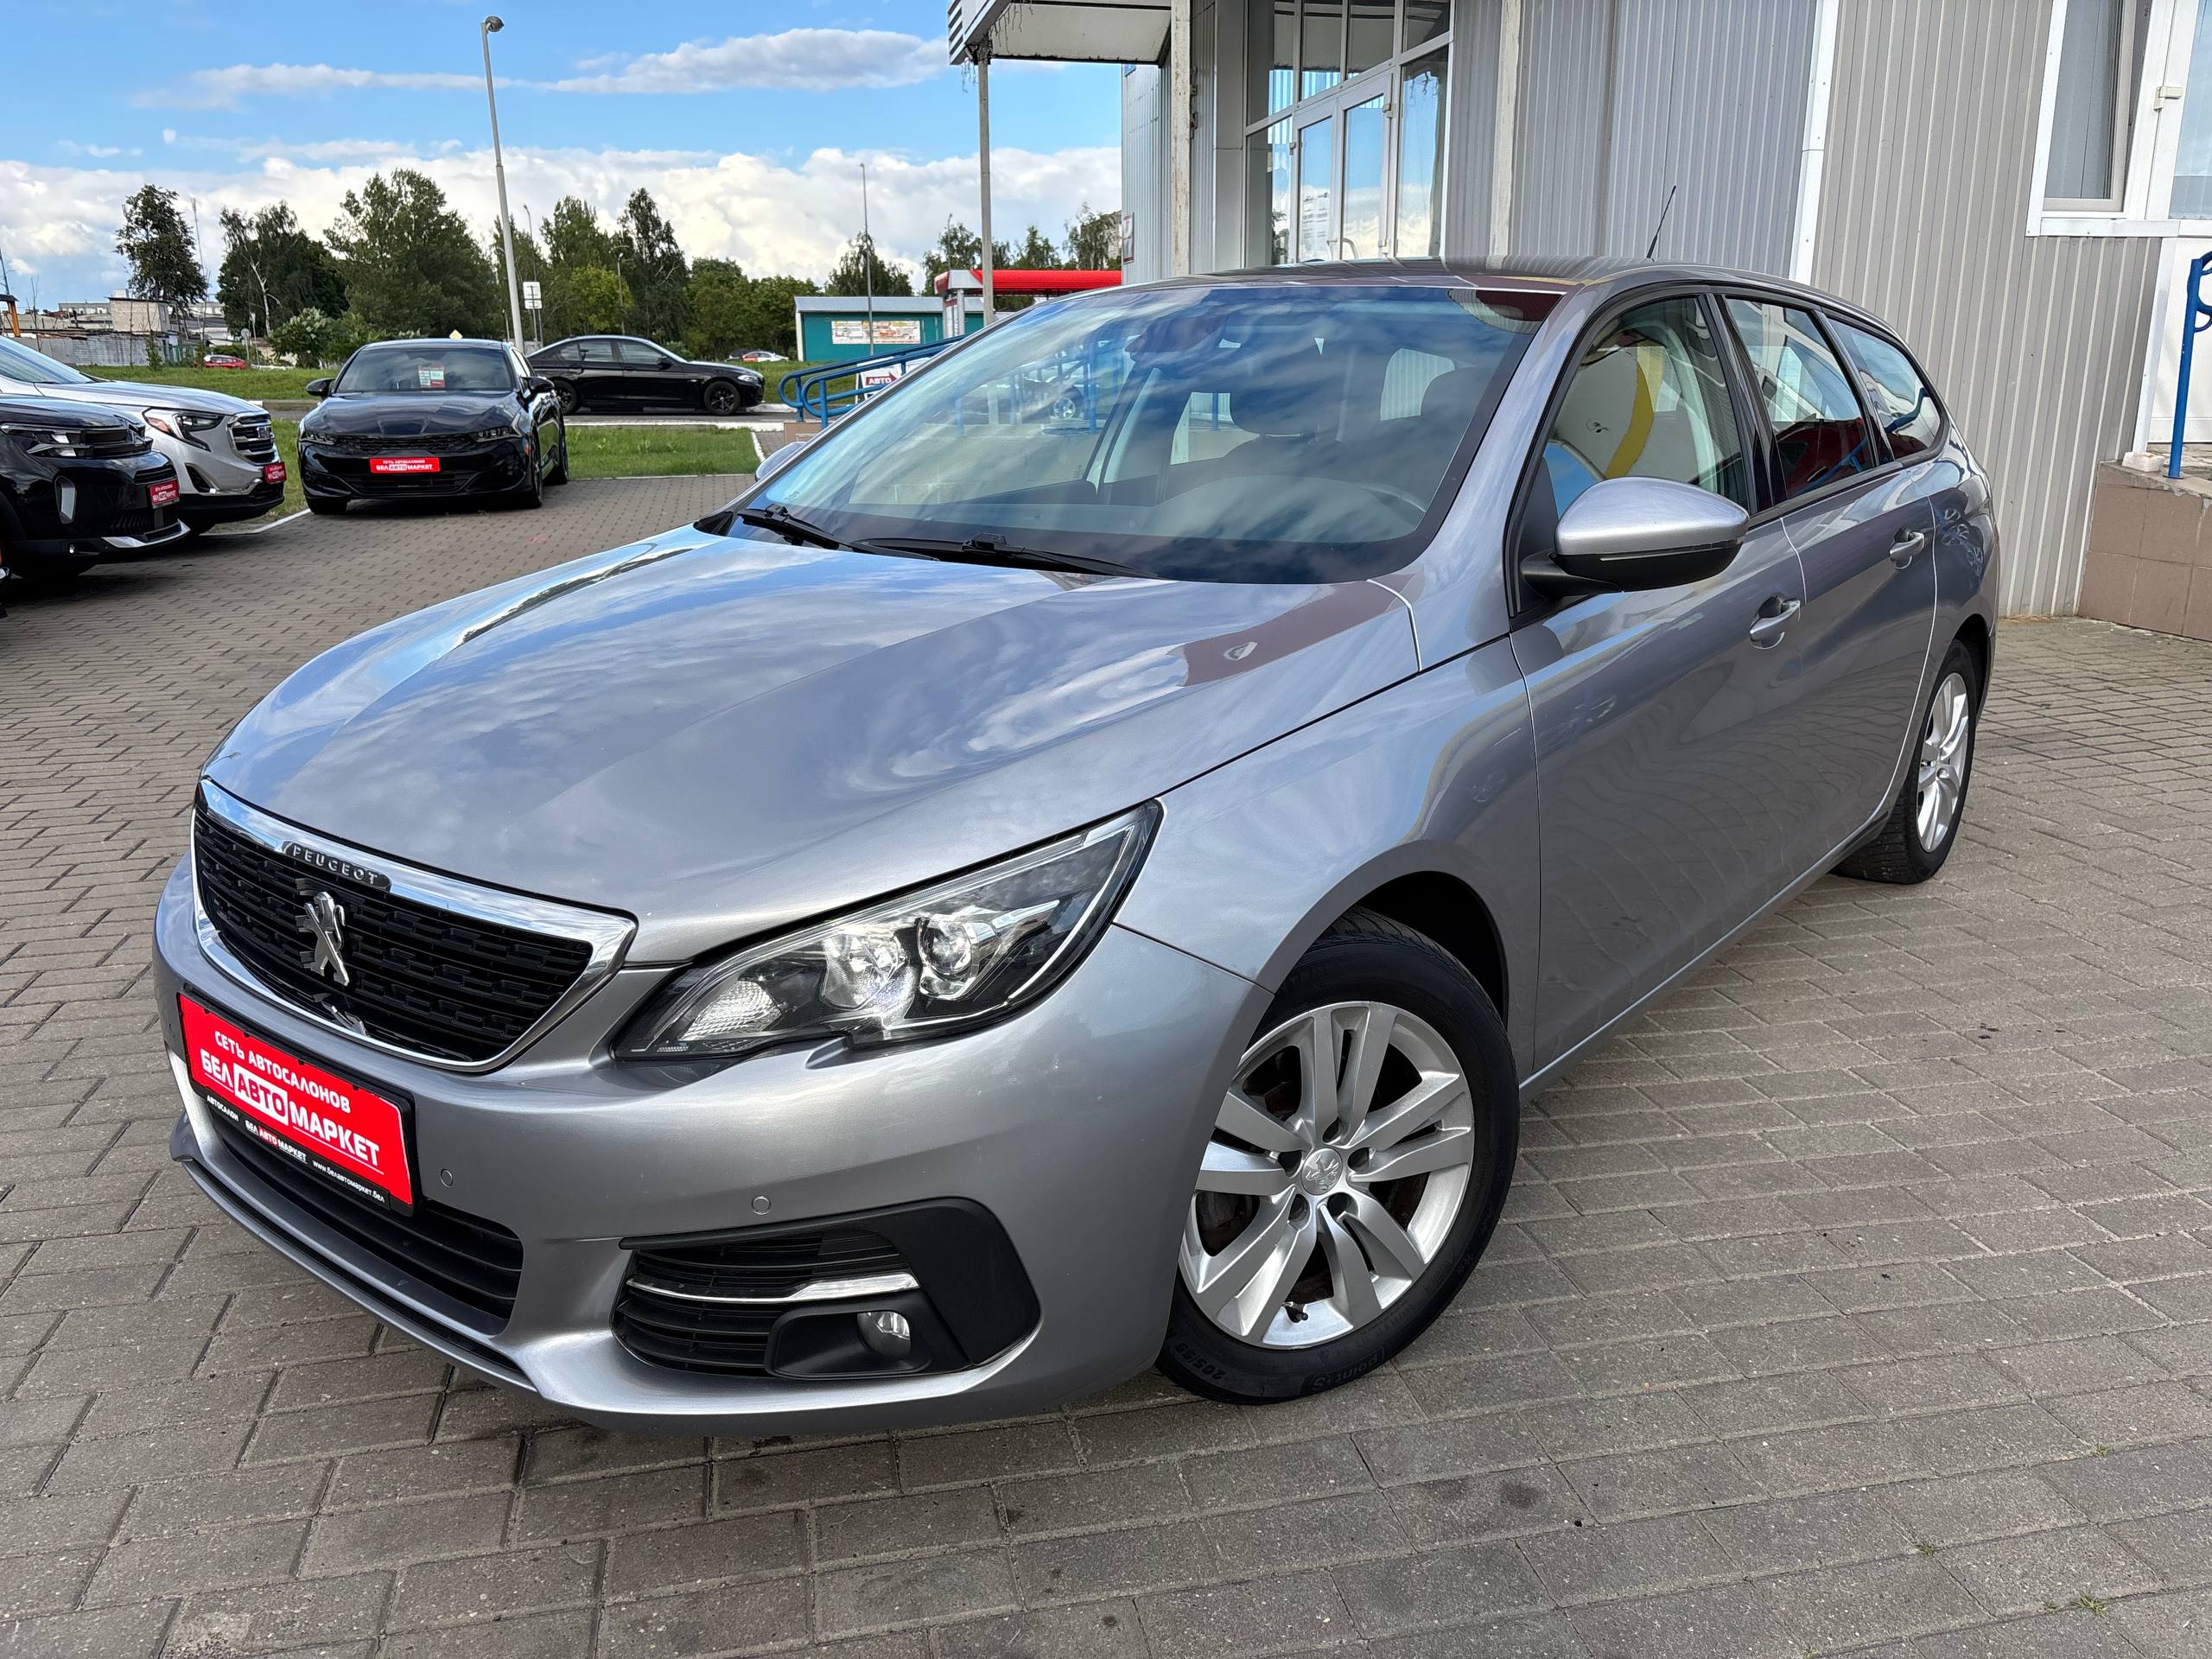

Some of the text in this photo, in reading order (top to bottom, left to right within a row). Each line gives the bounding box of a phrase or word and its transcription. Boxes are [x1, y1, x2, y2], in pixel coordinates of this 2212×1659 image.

[292, 844, 378, 885] PEUGEOT
[214, 1031, 351, 1114] СЕТЬ АВТОСАЛОНОВ
[207, 1095, 238, 1122] АВТОСАЛОН
